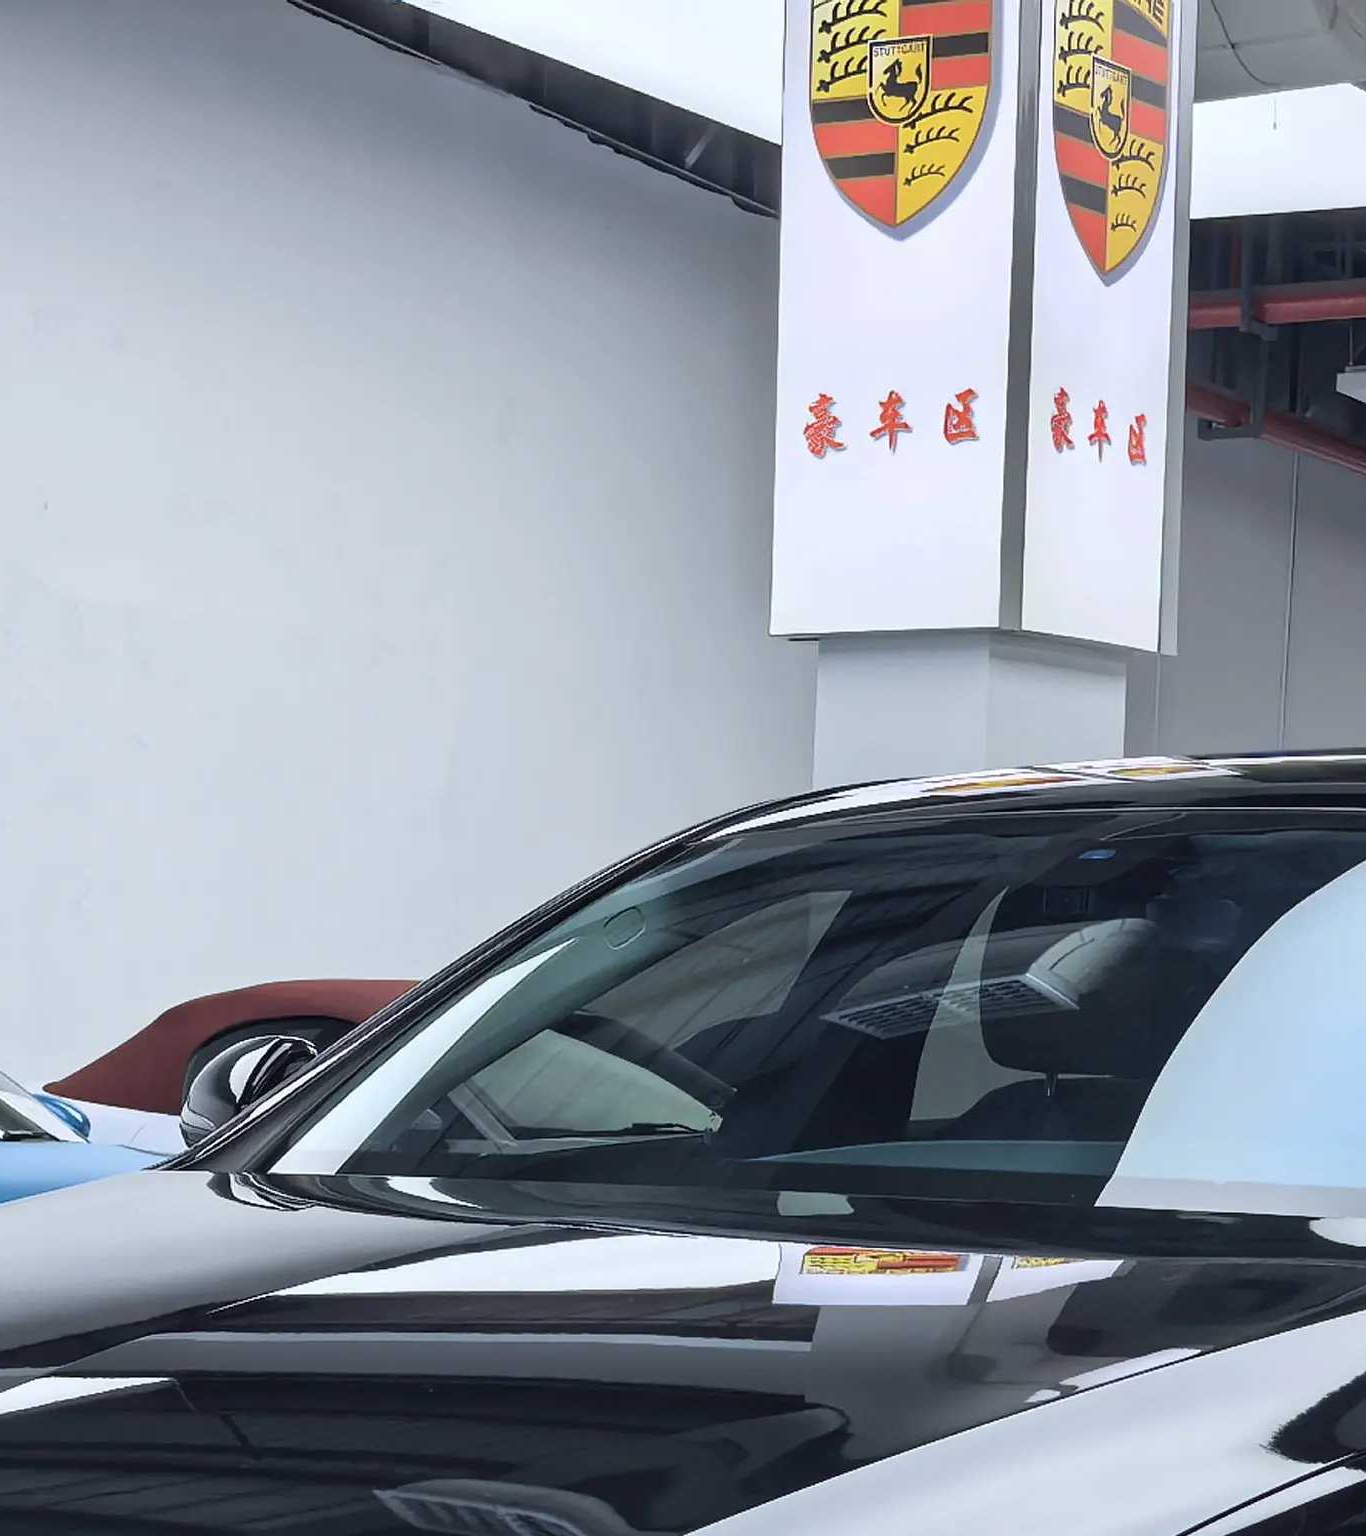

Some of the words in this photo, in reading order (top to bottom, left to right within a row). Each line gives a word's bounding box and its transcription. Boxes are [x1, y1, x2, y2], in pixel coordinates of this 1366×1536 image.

[803, 388, 980, 458] 豪车区
[1051, 386, 1147, 465] 豪车区
